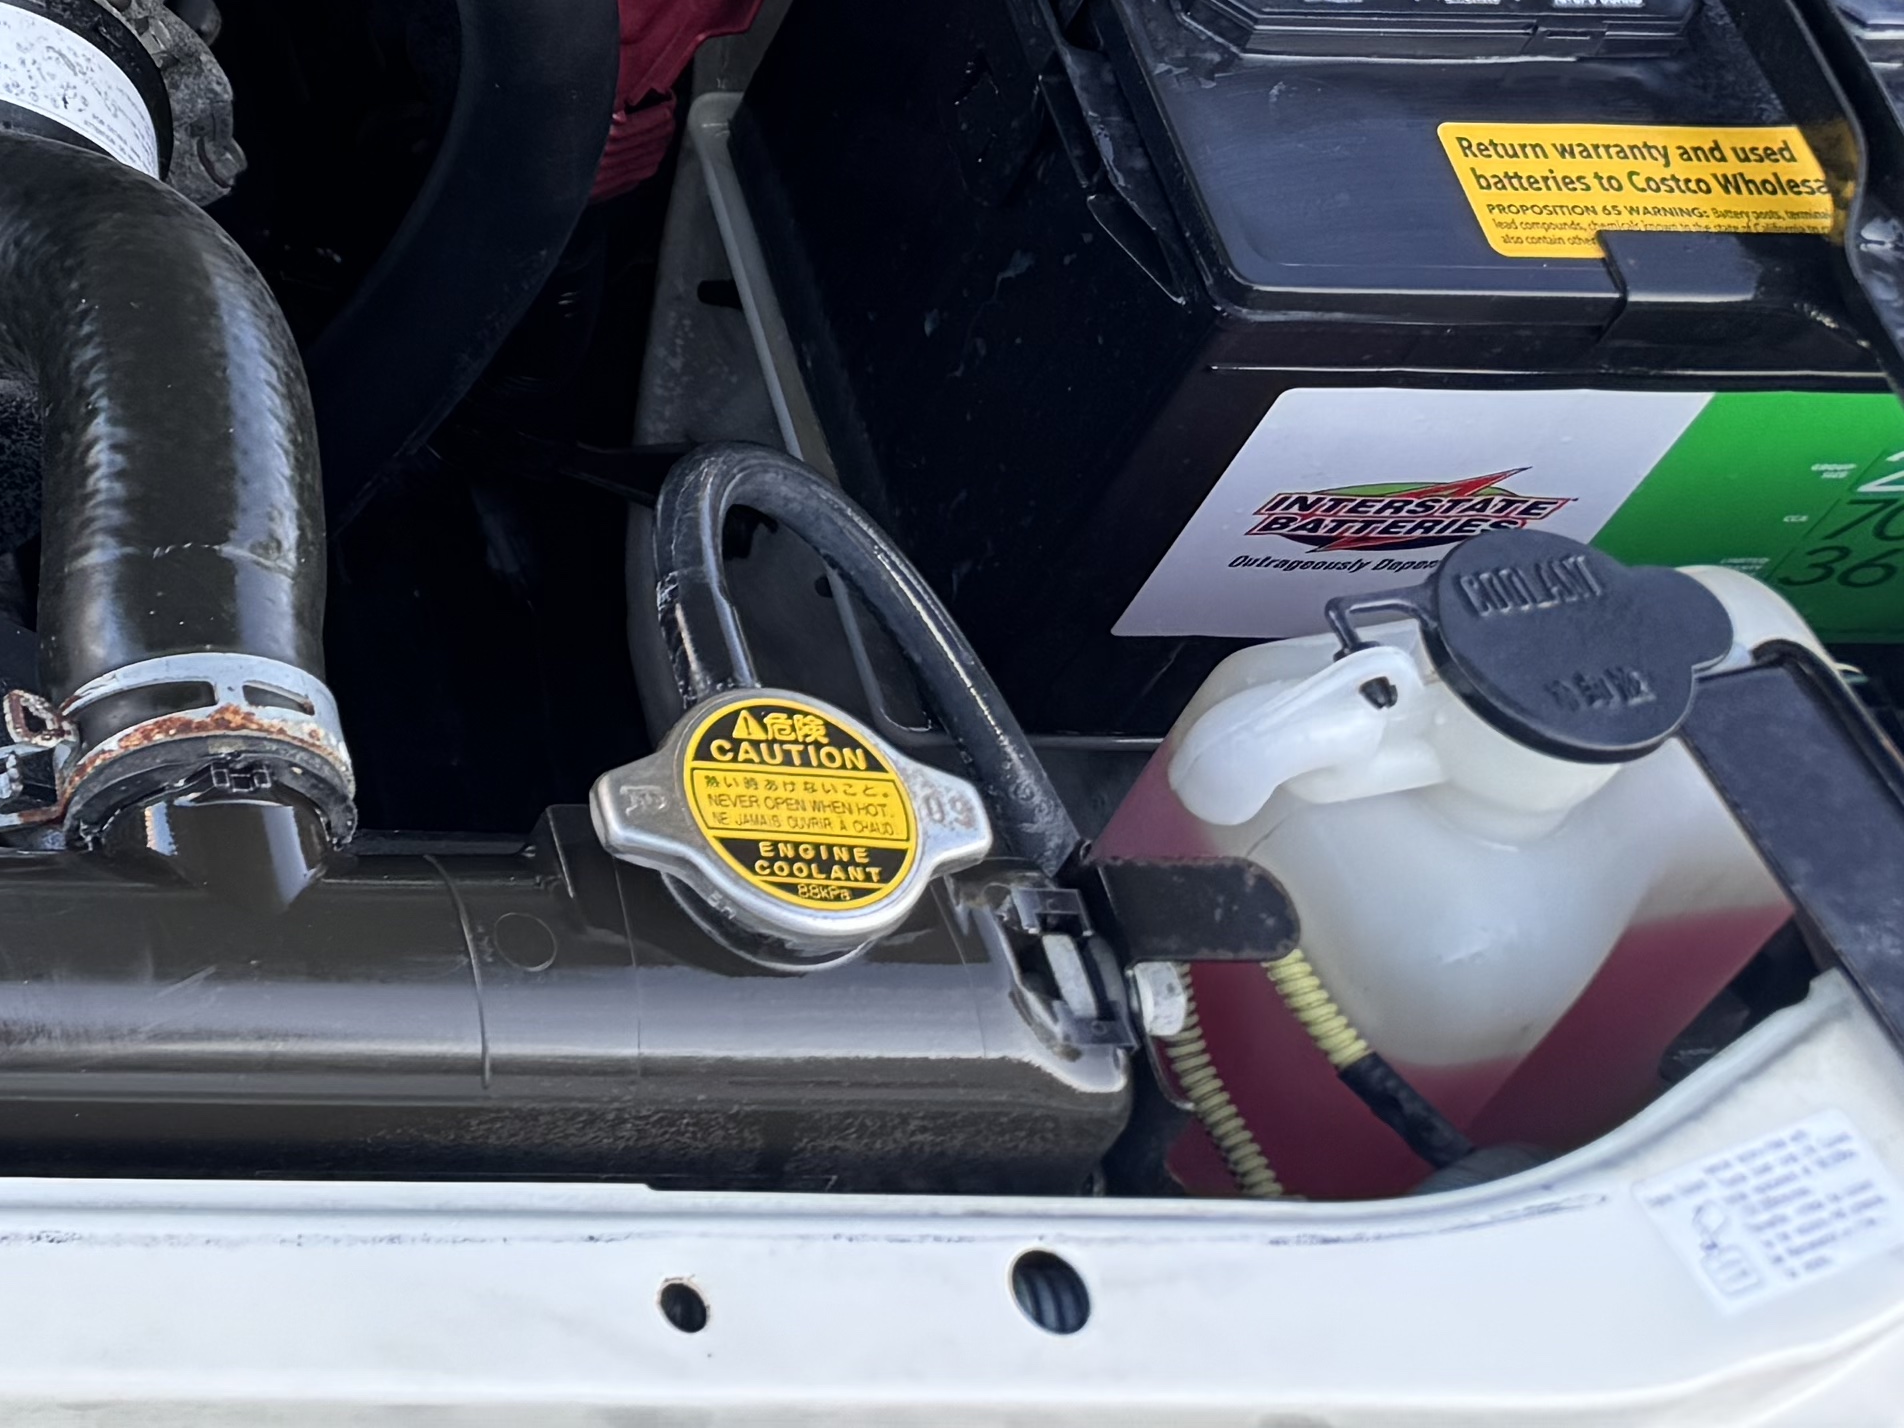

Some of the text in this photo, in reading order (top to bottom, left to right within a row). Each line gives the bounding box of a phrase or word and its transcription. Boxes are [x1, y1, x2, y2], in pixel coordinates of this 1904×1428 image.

[1455, 135, 1798, 169] Return warranty and used
[1469, 166, 1829, 196] batteries to Costco Wholesa
[1485, 203, 1599, 217] PROPOSITION
[1601, 204, 1623, 217] 65
[1623, 204, 1711, 220] WARNING:
[1712, 207, 1751, 222] Battery
[1784, 209, 1830, 220] terminal
[1491, 217, 1518, 230] lead
[1519, 219, 1588, 233] compounds,
[1500, 233, 1524, 245] also
[1525, 234, 1567, 245] contain
[1264, 494, 1560, 517] INTERSTATE
[1227, 554, 1441, 573] Outrageously Depen
[1456, 555, 1602, 618] COOLANT
[762, 710, 830, 745] 危険
[709, 738, 868, 771] CAUTION
[707, 793, 896, 819] NEVER OPEN WHEN HOT.
[712, 811, 729, 826] NE
[734, 813, 783, 828] JAMAIS
[786, 815, 834, 831] OUVRIR
[758, 840, 870, 864] ENGINE
[754, 858, 883, 883] COOLANT
[797, 882, 853, 901] 88kPa
